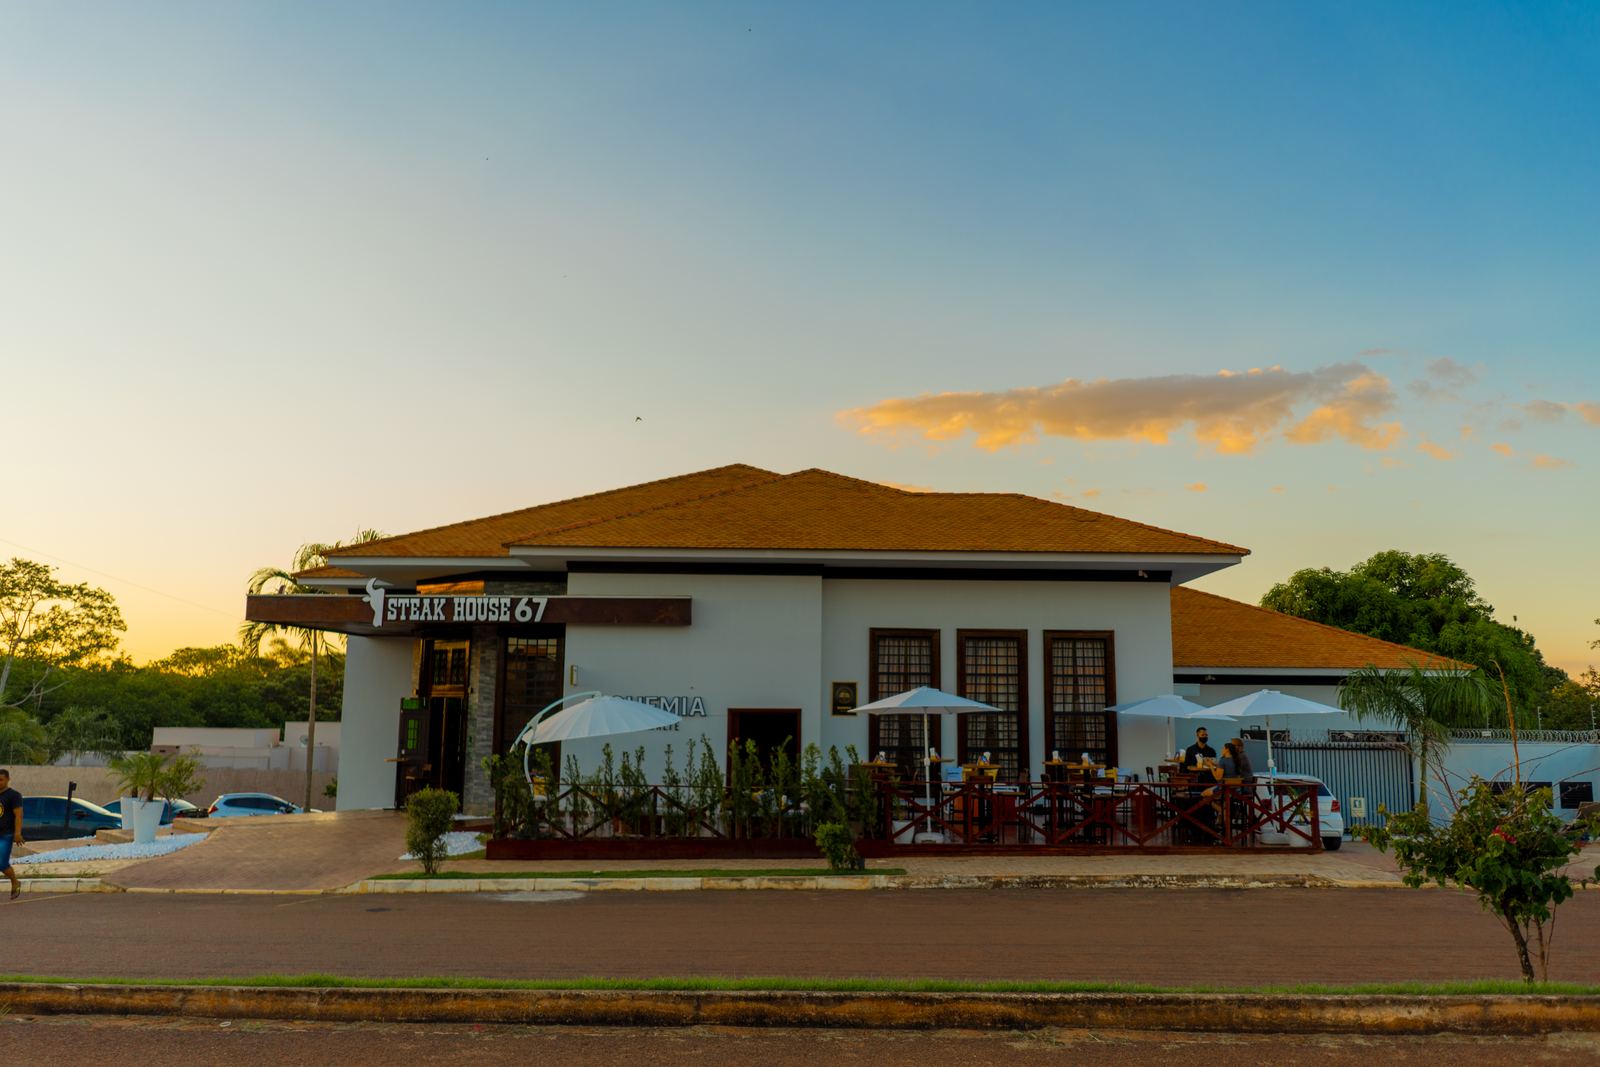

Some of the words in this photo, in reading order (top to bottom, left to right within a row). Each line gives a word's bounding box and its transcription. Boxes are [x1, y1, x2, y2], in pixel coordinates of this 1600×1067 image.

[387, 598, 446, 621] STEAK
[453, 597, 511, 622] HOUSE
[514, 597, 548, 623] 67
